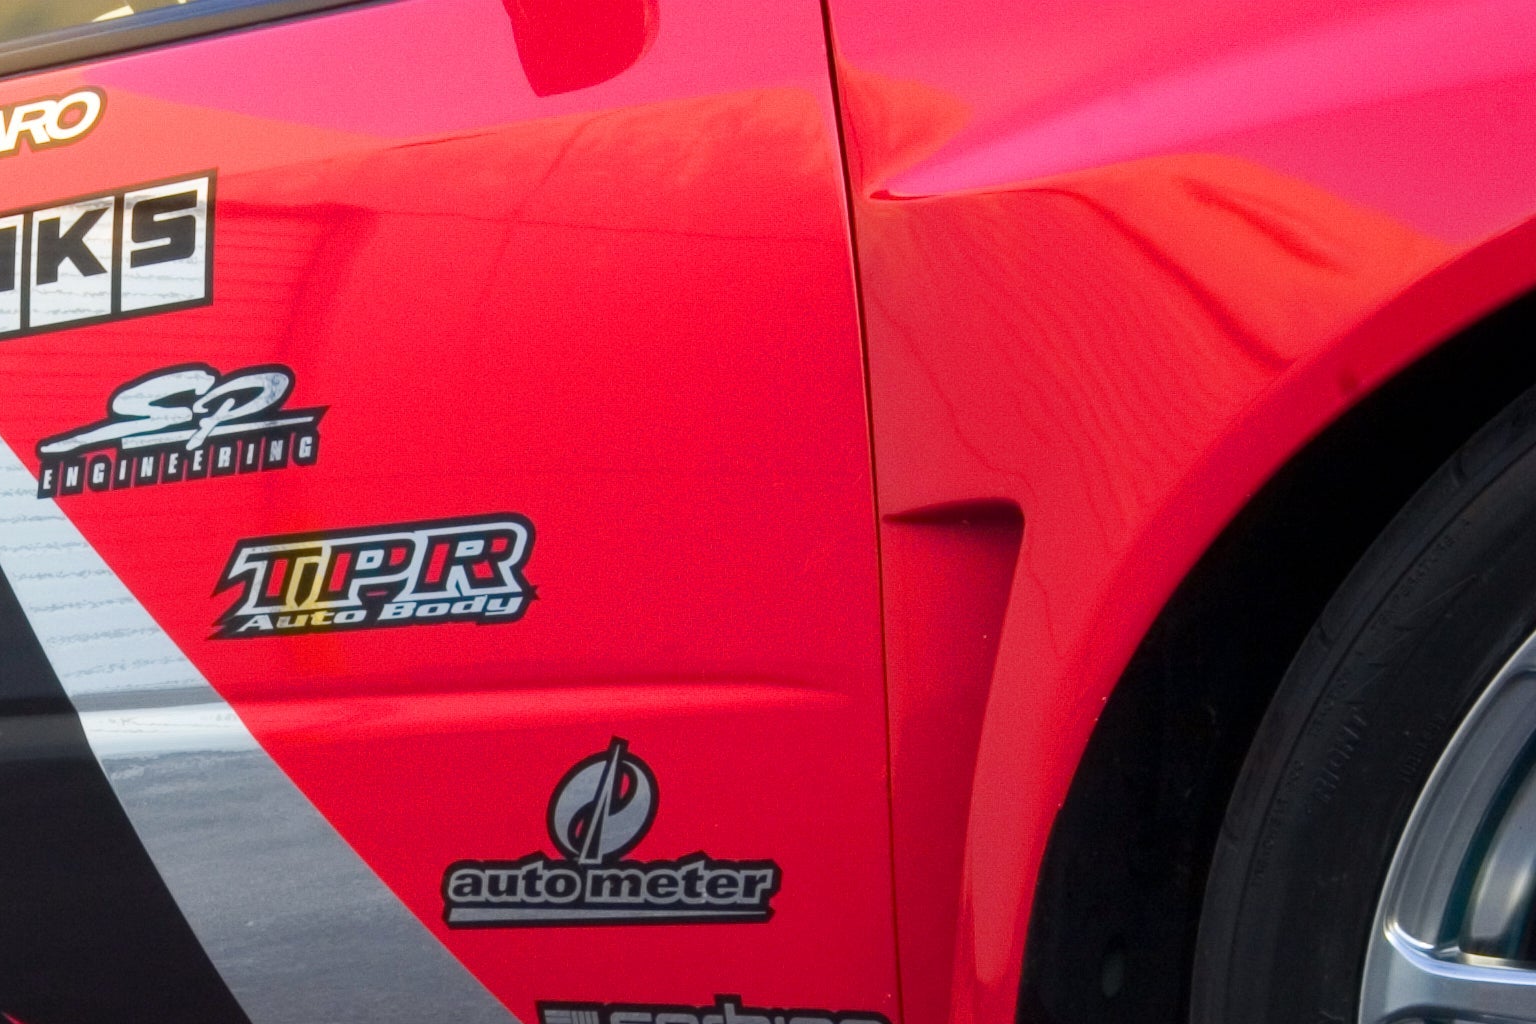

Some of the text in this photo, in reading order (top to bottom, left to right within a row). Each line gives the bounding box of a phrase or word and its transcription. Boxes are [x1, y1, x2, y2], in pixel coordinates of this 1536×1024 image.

[40, 368, 290, 451] SP
[42, 434, 314, 491] ENGINEERING
[226, 520, 531, 615] TPR
[237, 593, 524, 633] Auto Body
